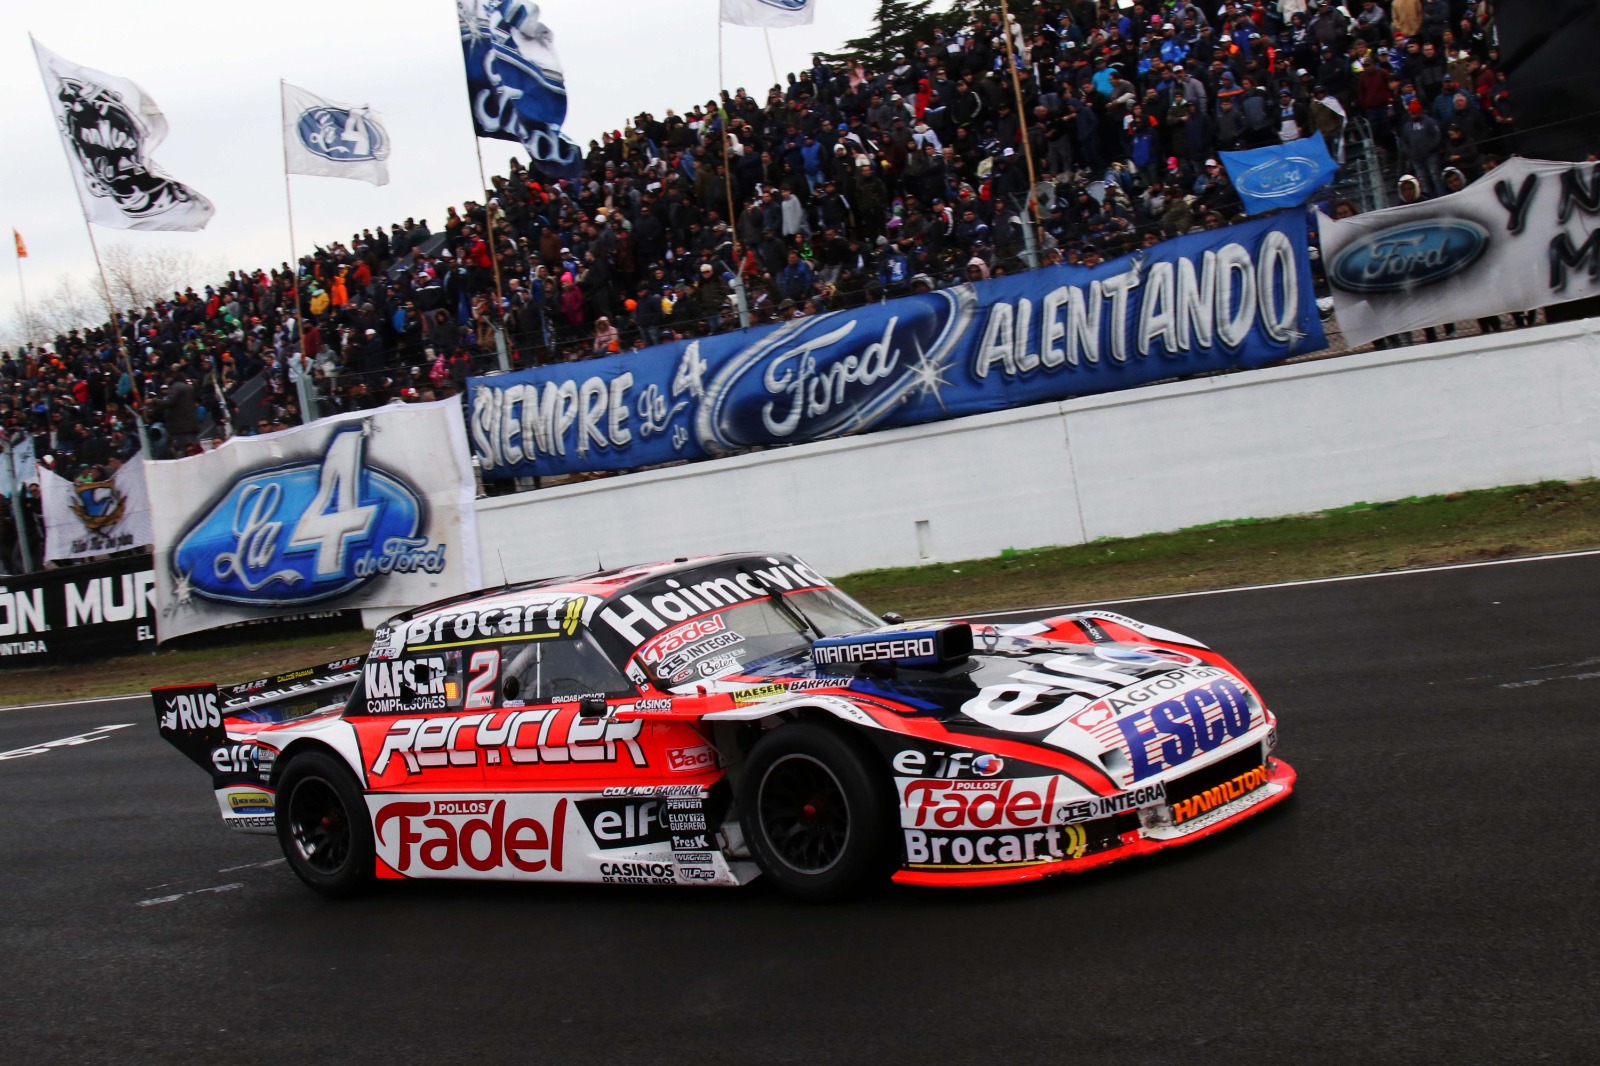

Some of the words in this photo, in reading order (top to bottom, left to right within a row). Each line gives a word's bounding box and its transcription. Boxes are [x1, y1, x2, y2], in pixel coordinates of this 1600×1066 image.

[341, 108, 369, 155] 4
[1494, 172, 1539, 236] Y
[1362, 232, 1452, 280] Ford
[975, 230, 1299, 379] ALENTANDO
[761, 315, 901, 437] Ford
[472, 370, 635, 472] SIEMPRE
[638, 384, 689, 437] La
[672, 340, 708, 398] 4
[672, 424, 689, 450] de
[213, 482, 305, 593] La
[285, 428, 381, 580] 4
[354, 550, 375, 578] de
[376, 536, 446, 575] Ford
[137, 625, 155, 641] EL
[407, 598, 569, 645] Brocart
[644, 614, 724, 662] Fadel
[686, 632, 742, 658] INTEGRA
[814, 637, 935, 664] MANASSERO
[225, 683, 305, 708] CABLE
[463, 649, 500, 711] 2
[735, 684, 784, 699] KAESER
[790, 678, 850, 691] BARPRAN
[960, 654, 1142, 733] elf
[176, 694, 221, 730] RUS
[551, 694, 577, 704] GRACIAS
[635, 698, 672, 710] CASINOS
[1116, 678, 1251, 783] ESCO
[212, 744, 252, 773] elf
[655, 784, 701, 797] BARPRAN
[903, 775, 1060, 829] Fadel
[956, 782, 998, 791] POLLOS
[1100, 780, 1166, 815] INTEGRA
[1172, 765, 1268, 824] HAMILTON
[225, 816, 276, 828] MANASSE
[438, 802, 487, 815] POLLOS
[593, 801, 657, 841] elf
[668, 813, 691, 824] ELOY
[670, 821, 707, 831] GUERRERO
[374, 797, 568, 872] Fadel
[904, 826, 1064, 864] Brocart
[600, 863, 675, 878] CASINOS
[602, 876, 616, 885] DE
[618, 875, 651, 885] ENTRE
[652, 875, 678, 885] RIOS
